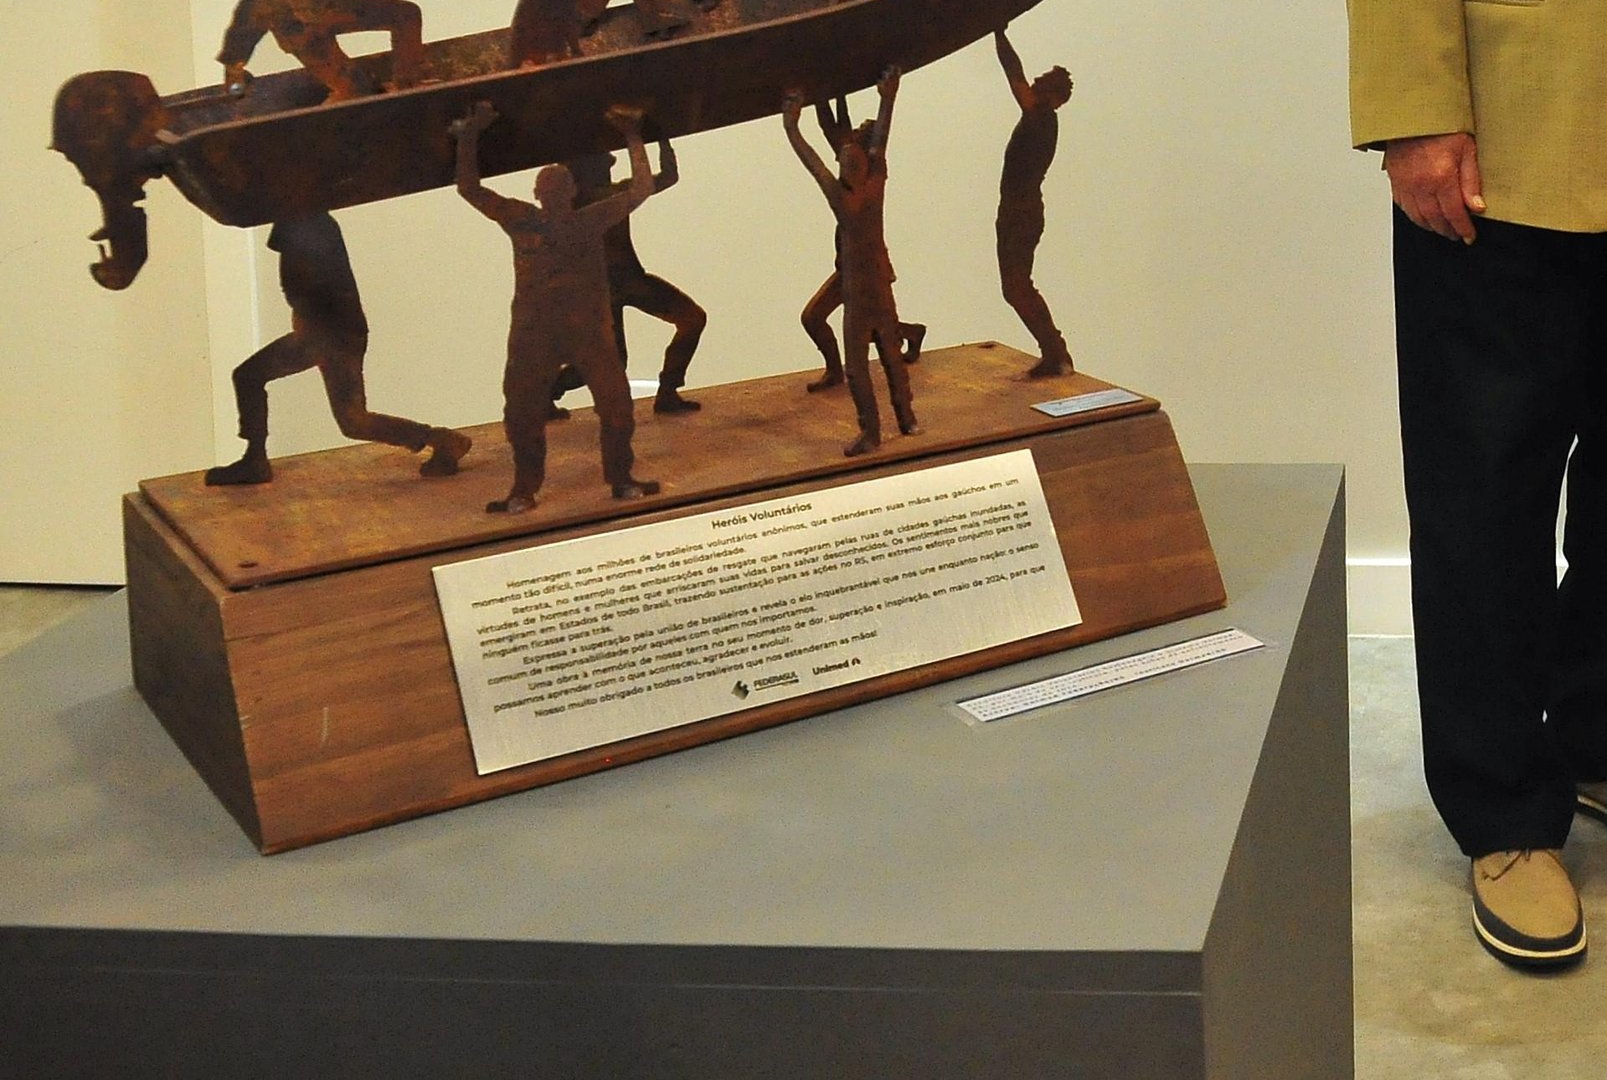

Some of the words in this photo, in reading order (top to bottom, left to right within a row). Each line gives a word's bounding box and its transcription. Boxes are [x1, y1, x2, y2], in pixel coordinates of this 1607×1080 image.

[711, 514, 748, 530] Heróis
[748, 502, 812, 521] Voluntários
[505, 570, 572, 589] Homenagem
[575, 566, 594, 575] aos
[596, 557, 636, 571] milhões
[654, 543, 704, 559] brasileiros
[706, 532, 758, 548] voluntários
[761, 522, 808, 537] anônimos,
[810, 518, 828, 527] que
[830, 506, 883, 523] estenderam
[885, 502, 905, 512] suas
[907, 496, 932, 507] mãos
[933, 493, 949, 501] aos
[951, 485, 986, 499] gaúchos
[812, 659, 849, 676] Unimed
[753, 671, 798, 688] FEDERASUL
